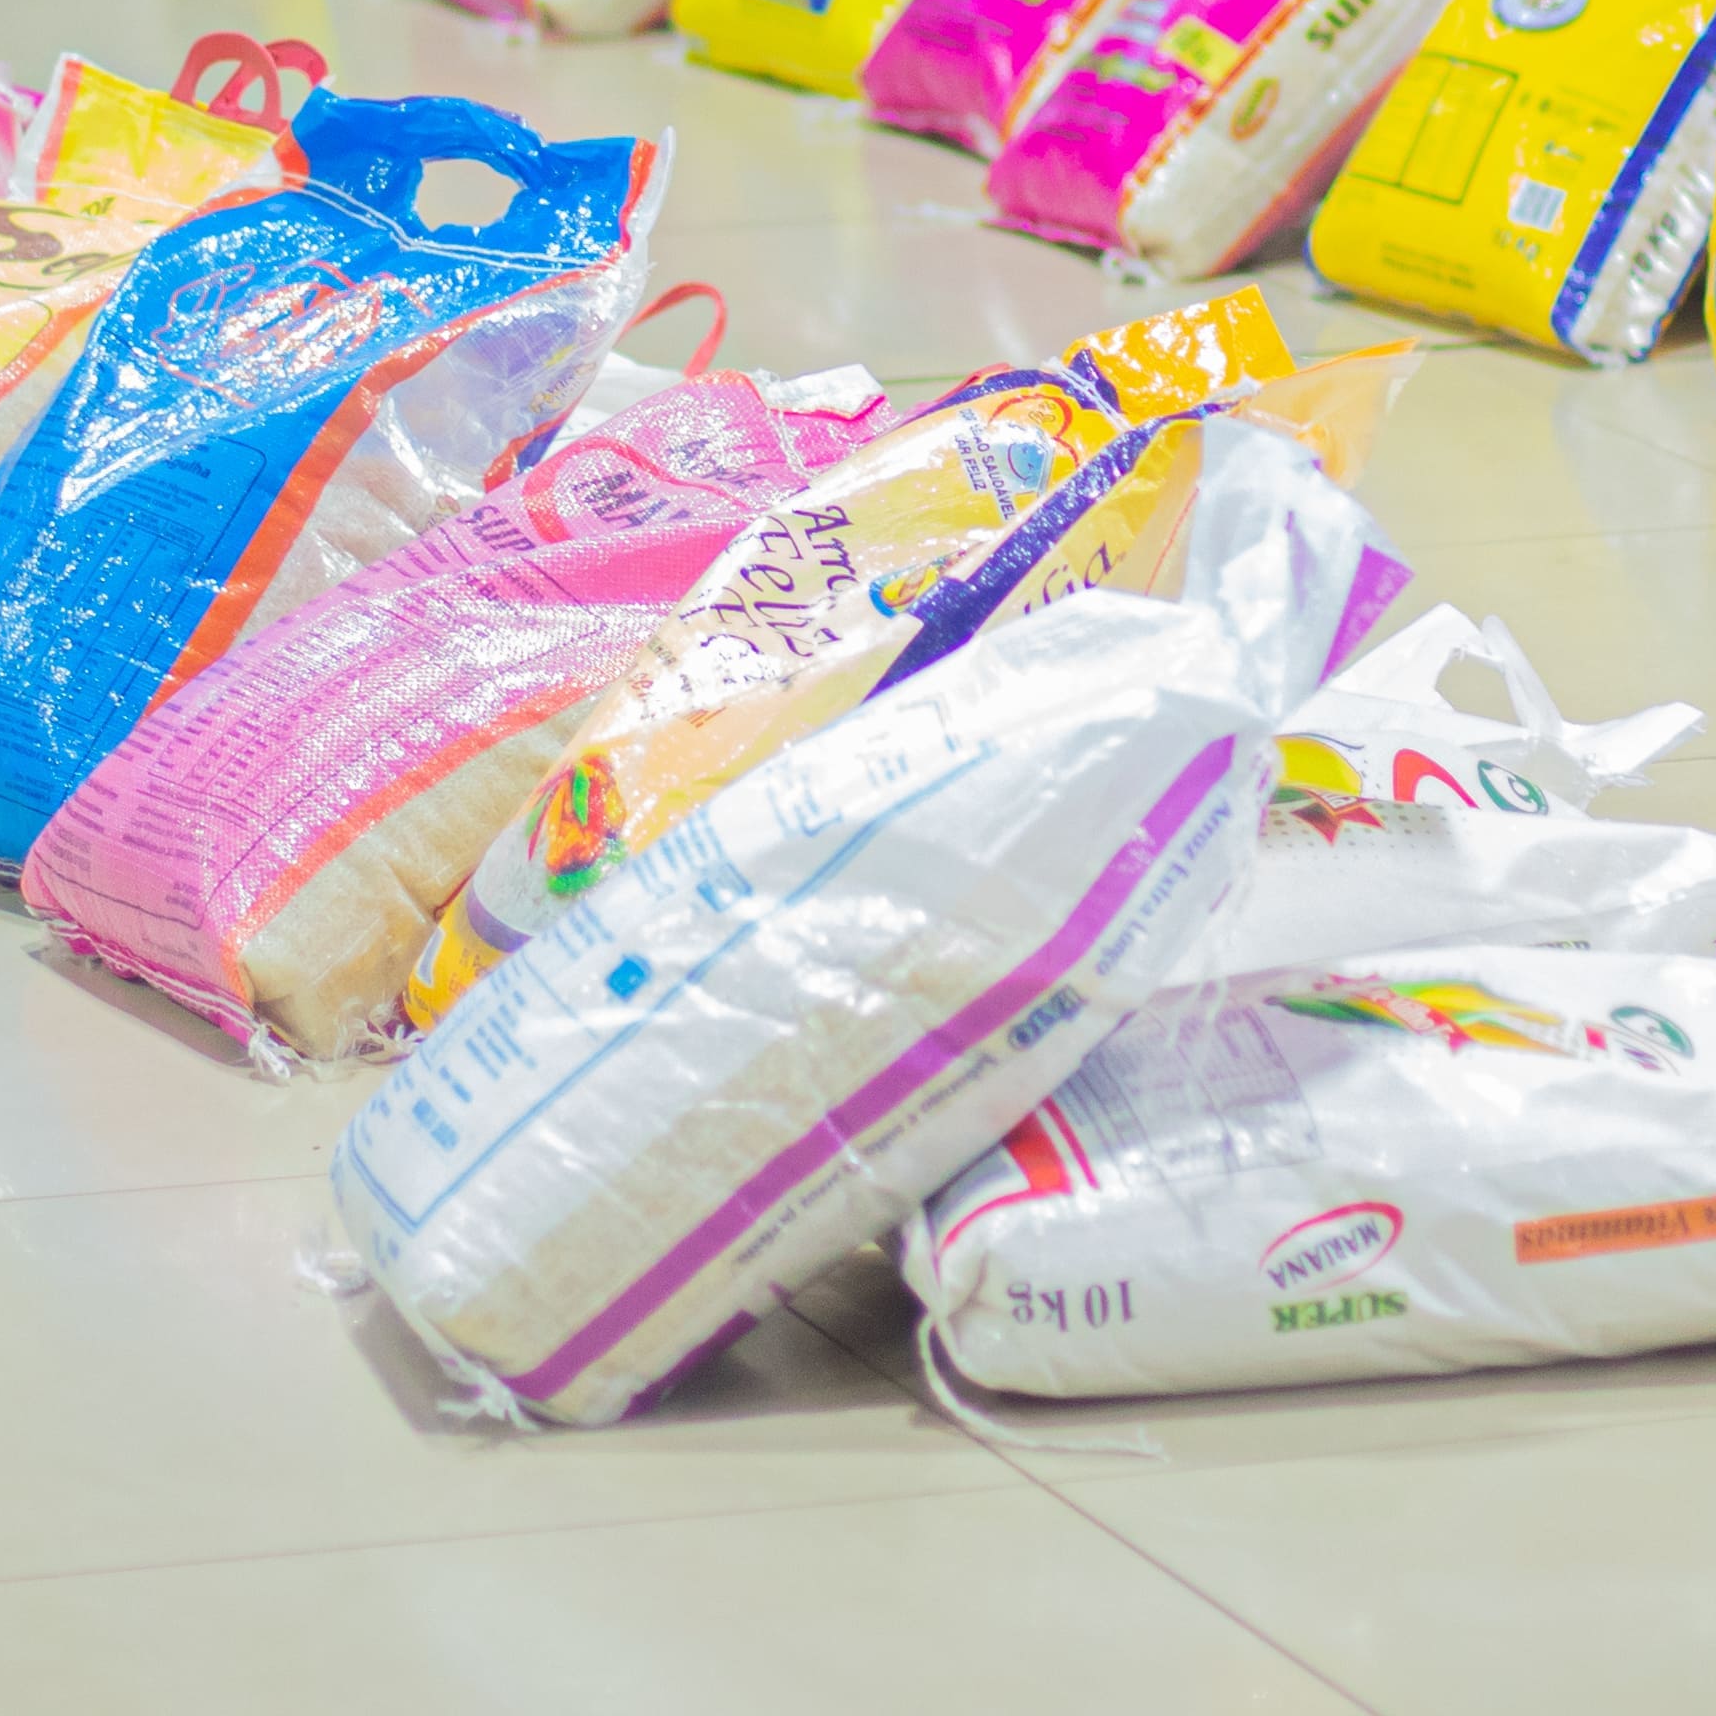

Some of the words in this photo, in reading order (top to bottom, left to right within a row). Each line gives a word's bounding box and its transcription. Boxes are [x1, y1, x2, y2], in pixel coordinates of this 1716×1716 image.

[963, 456, 988, 492] FELIZ
[982, 455, 1017, 522] SAUDÁVEL
[1266, 1216, 1385, 1292] MARIANA
[1006, 1279, 1071, 1334] kg
[1082, 1278, 1136, 1331] 10
[1269, 1288, 1410, 1334] SUPER
